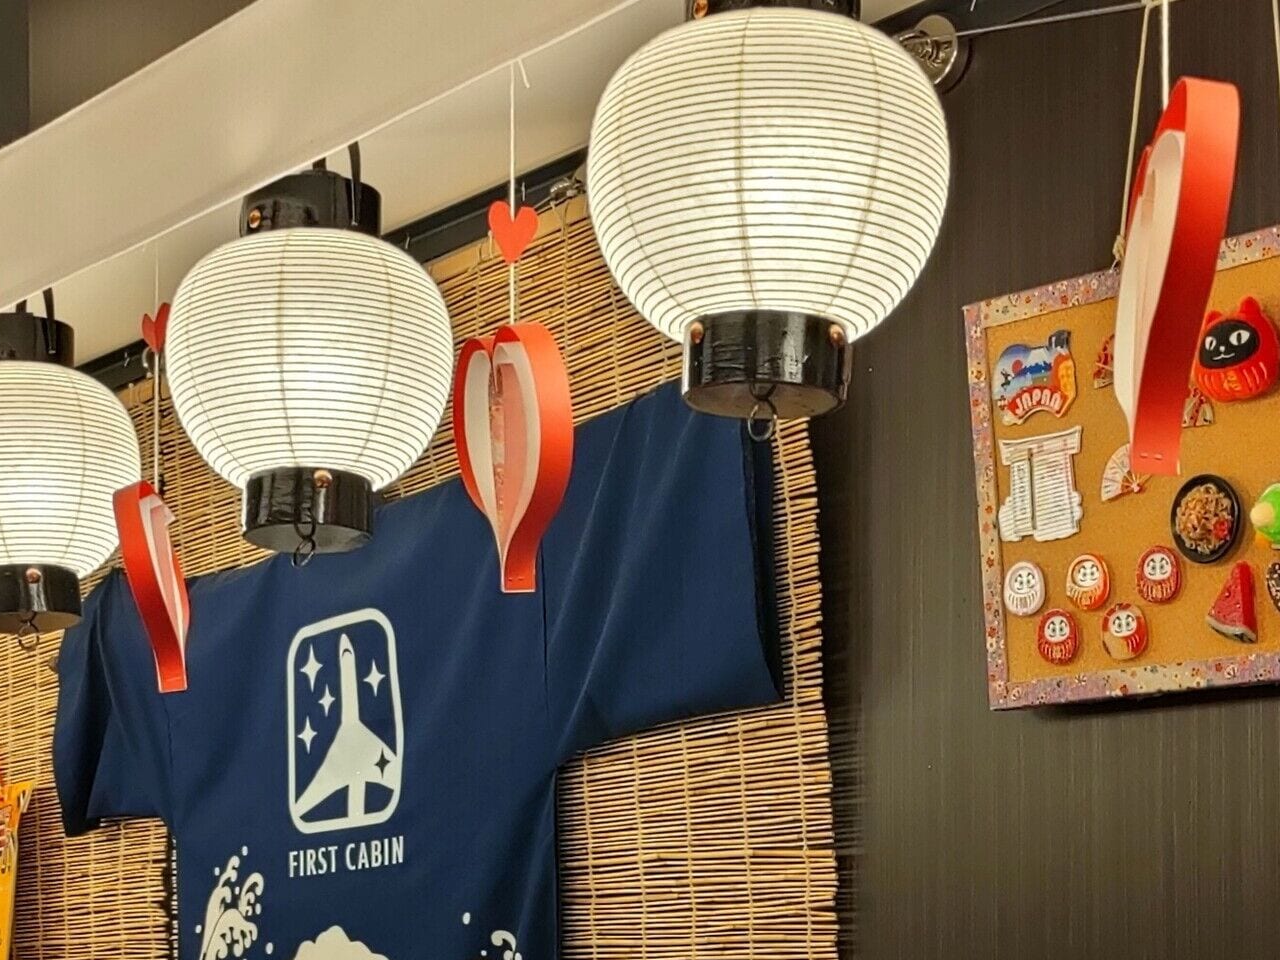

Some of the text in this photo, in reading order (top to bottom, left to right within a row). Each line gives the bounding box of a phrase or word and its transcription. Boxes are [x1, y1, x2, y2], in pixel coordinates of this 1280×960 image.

[1015, 388, 1062, 416] JAPAN
[289, 835, 404, 878] FIRST CABIN
